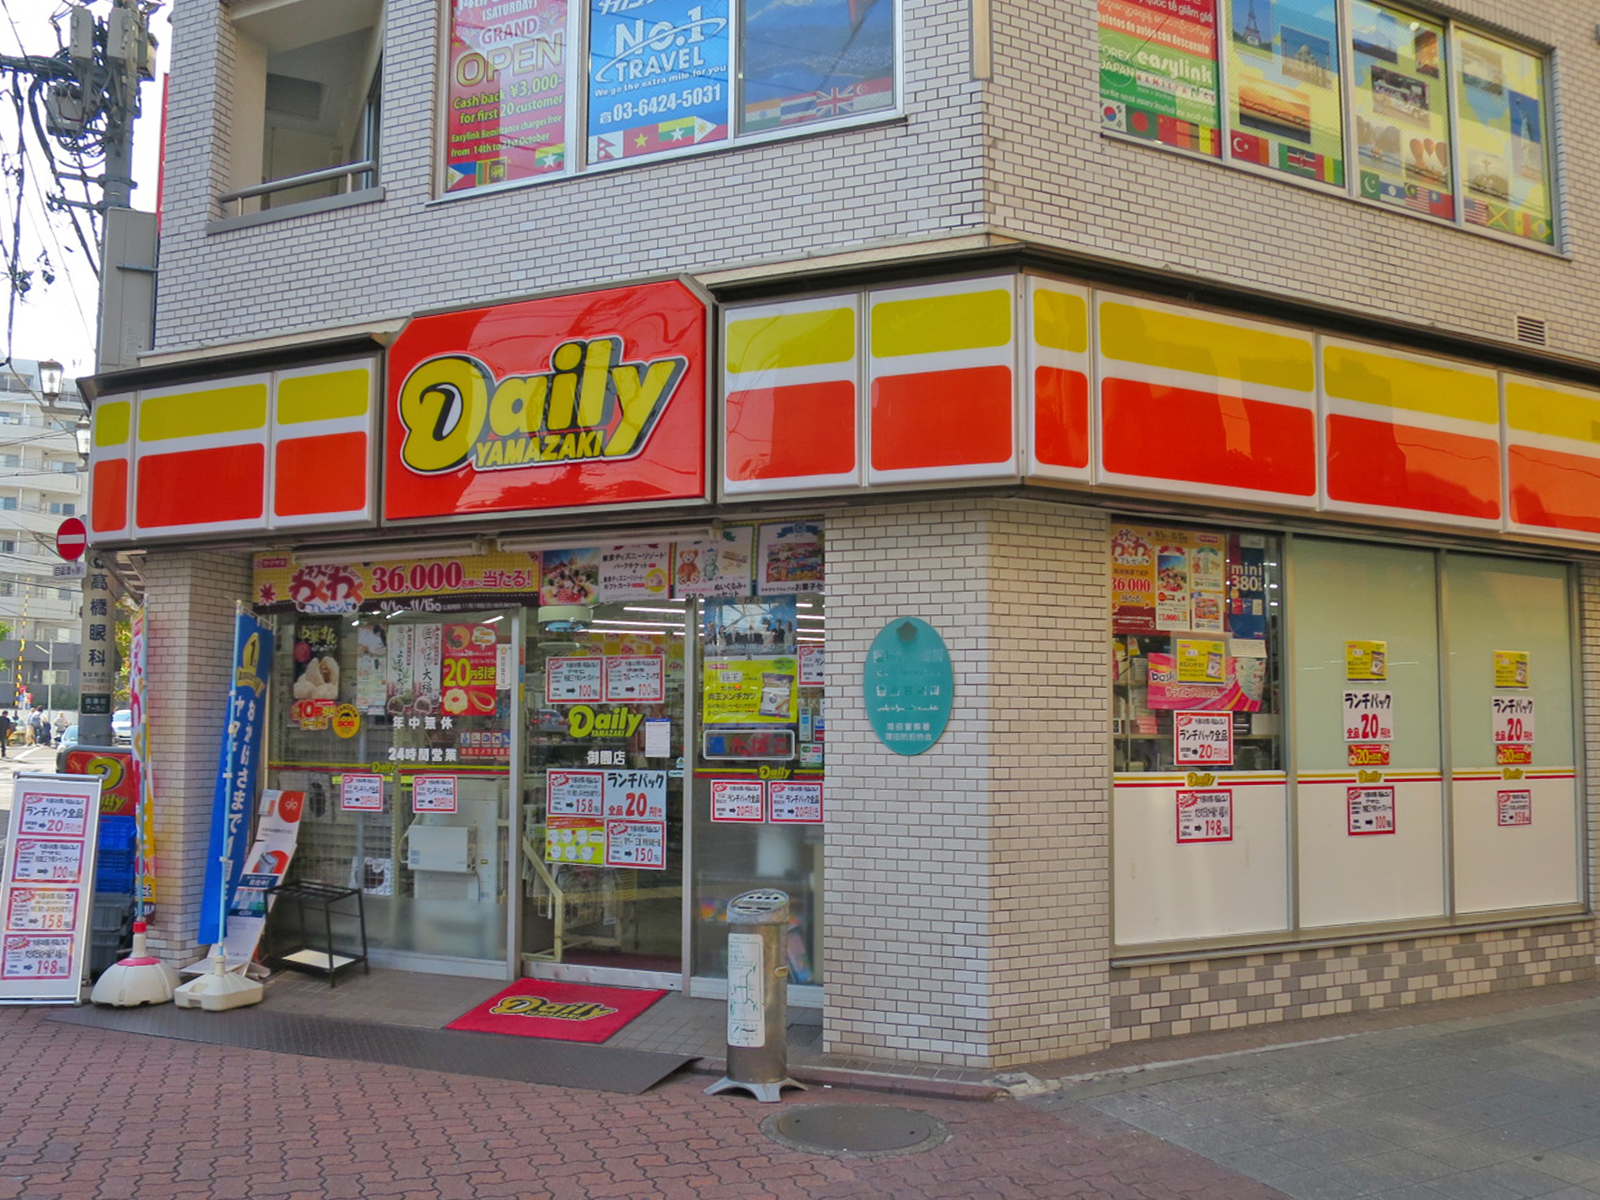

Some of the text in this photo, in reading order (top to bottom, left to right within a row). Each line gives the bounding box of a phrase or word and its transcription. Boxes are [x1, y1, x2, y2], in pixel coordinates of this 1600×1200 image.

[482, 18, 538, 45] GRAND
[456, 32, 563, 87] OPEN
[615, 46, 704, 82] TRAVEL
[1100, 59, 1136, 77] JAPAN
[1137, 51, 1213, 84] easylink
[595, 65, 727, 97] We go the extra mile for you
[453, 95, 479, 109] Cash
[481, 91, 506, 105] back
[460, 95, 564, 124] for first 20 customer
[613, 83, 721, 121] 03-6424-5031
[451, 114, 562, 143] Easylink Remittance charges free
[451, 148, 471, 158] from
[473, 143, 492, 154] 14th
[493, 143, 500, 151] to
[519, 133, 549, 146] October
[397, 337, 690, 475] Daily
[474, 430, 608, 466] YAMAZAKI
[1230, 562, 1263, 578] mini
[1230, 577, 1258, 594] 380
[89, 573, 109, 668] 高橋眼科
[1344, 692, 1391, 709] ランチパック
[1493, 698, 1533, 714] ランチパック
[392, 716, 453, 732] 年中無休
[567, 704, 649, 738] Daily
[1361, 713, 1379, 739] 20
[1507, 717, 1523, 741] 20
[1180, 729, 1229, 743] ランチパック全品
[388, 747, 458, 765] 24時間営業
[607, 772, 664, 796] ランチパック
[759, 766, 792, 779] Daily
[1186, 772, 1216, 788] Daily
[26, 806, 85, 819] ランチパック全品
[576, 798, 594, 813] 158
[626, 792, 648, 816] 20
[1206, 819, 1222, 836] 198
[634, 847, 653, 862] 150
[41, 915, 63, 928] 158
[37, 960, 58, 974] 198
[489, 996, 619, 1021] Daily
